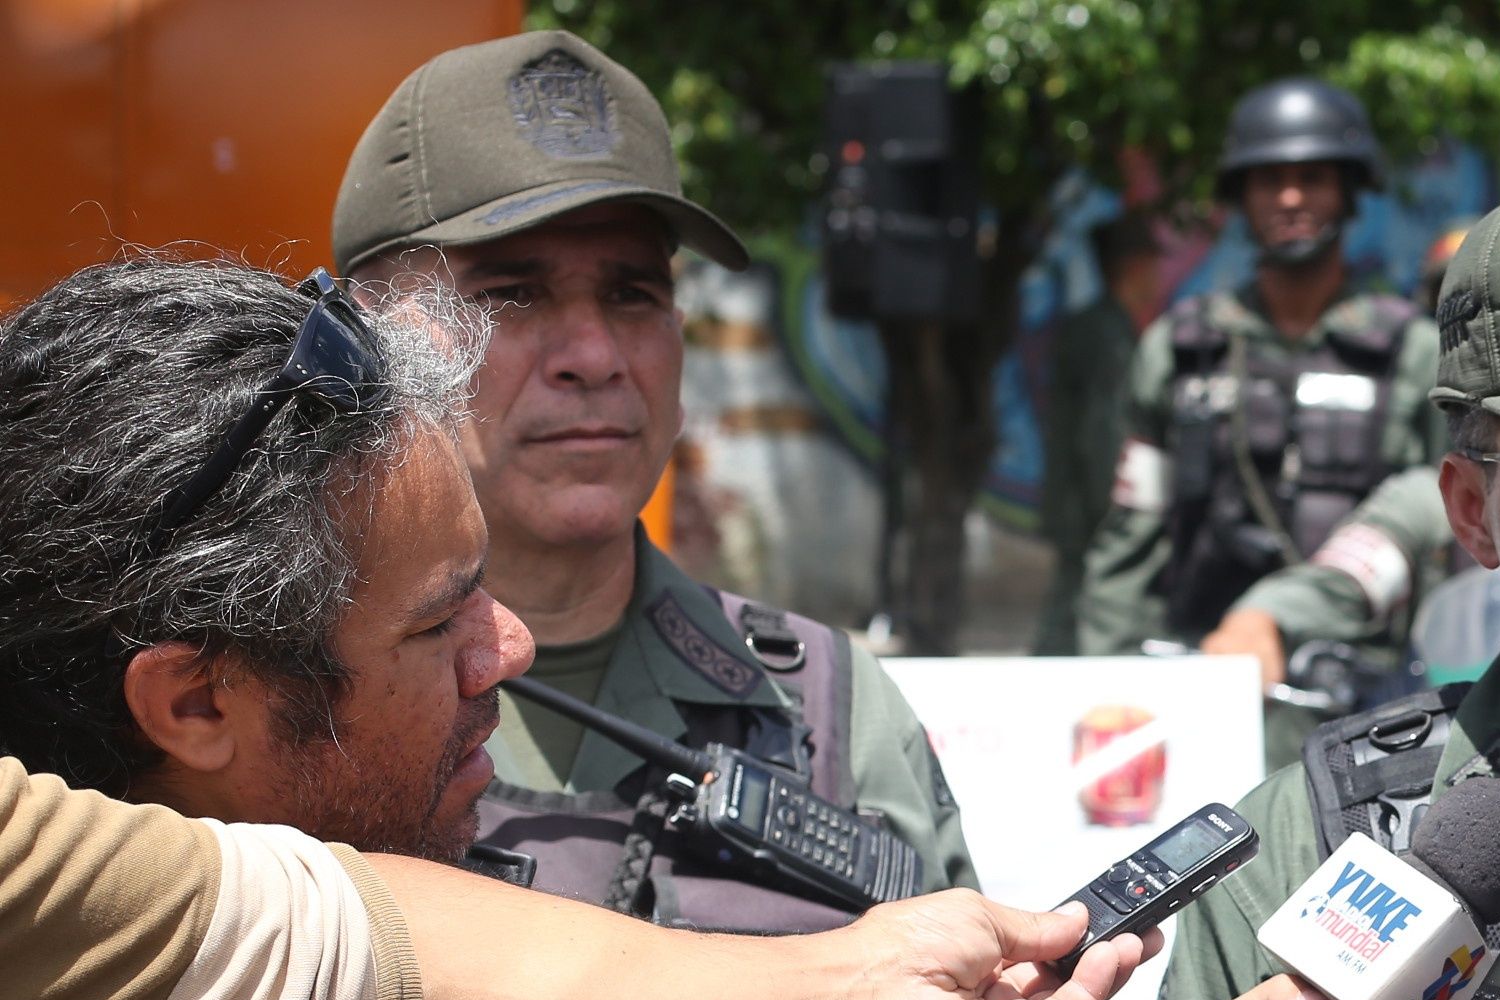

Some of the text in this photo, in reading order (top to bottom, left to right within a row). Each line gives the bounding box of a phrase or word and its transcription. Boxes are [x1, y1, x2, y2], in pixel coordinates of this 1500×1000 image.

[1207, 813, 1233, 833] SONY
[1327, 861, 1422, 943] YVKE
[1316, 908, 1390, 964] mundial
